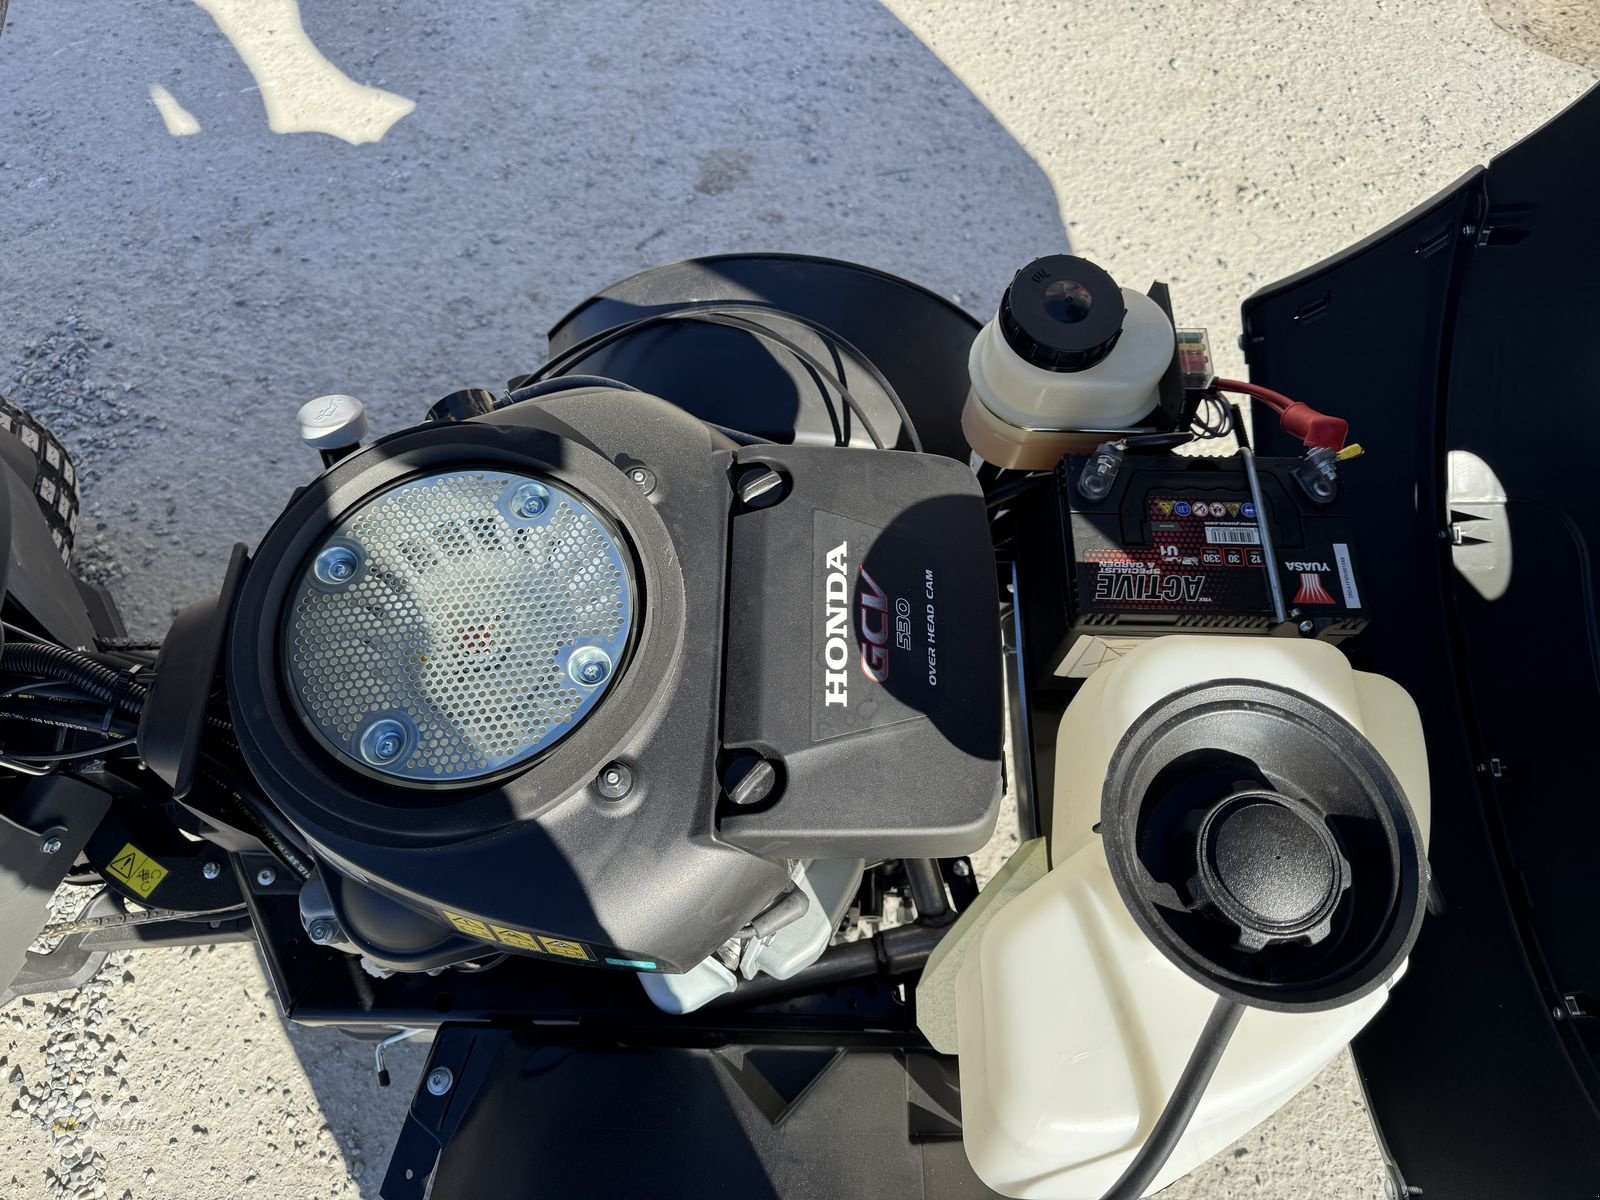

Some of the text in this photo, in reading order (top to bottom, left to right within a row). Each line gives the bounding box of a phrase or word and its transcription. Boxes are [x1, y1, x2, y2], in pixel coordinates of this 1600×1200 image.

[1031, 267, 1052, 283] OIL
[1160, 545, 1179, 556] U1
[1203, 553, 1221, 563] 330
[1228, 554, 1240, 563] 30
[1250, 554, 1262, 564] 12
[1284, 561, 1331, 572] YUASA
[1095, 574, 1205, 601] ACTIVE
[825, 541, 848, 707] HONDA
[859, 564, 889, 683] GCV
[895, 597, 912, 651] 530
[925, 569, 937, 686] OVER HEAD CAM
